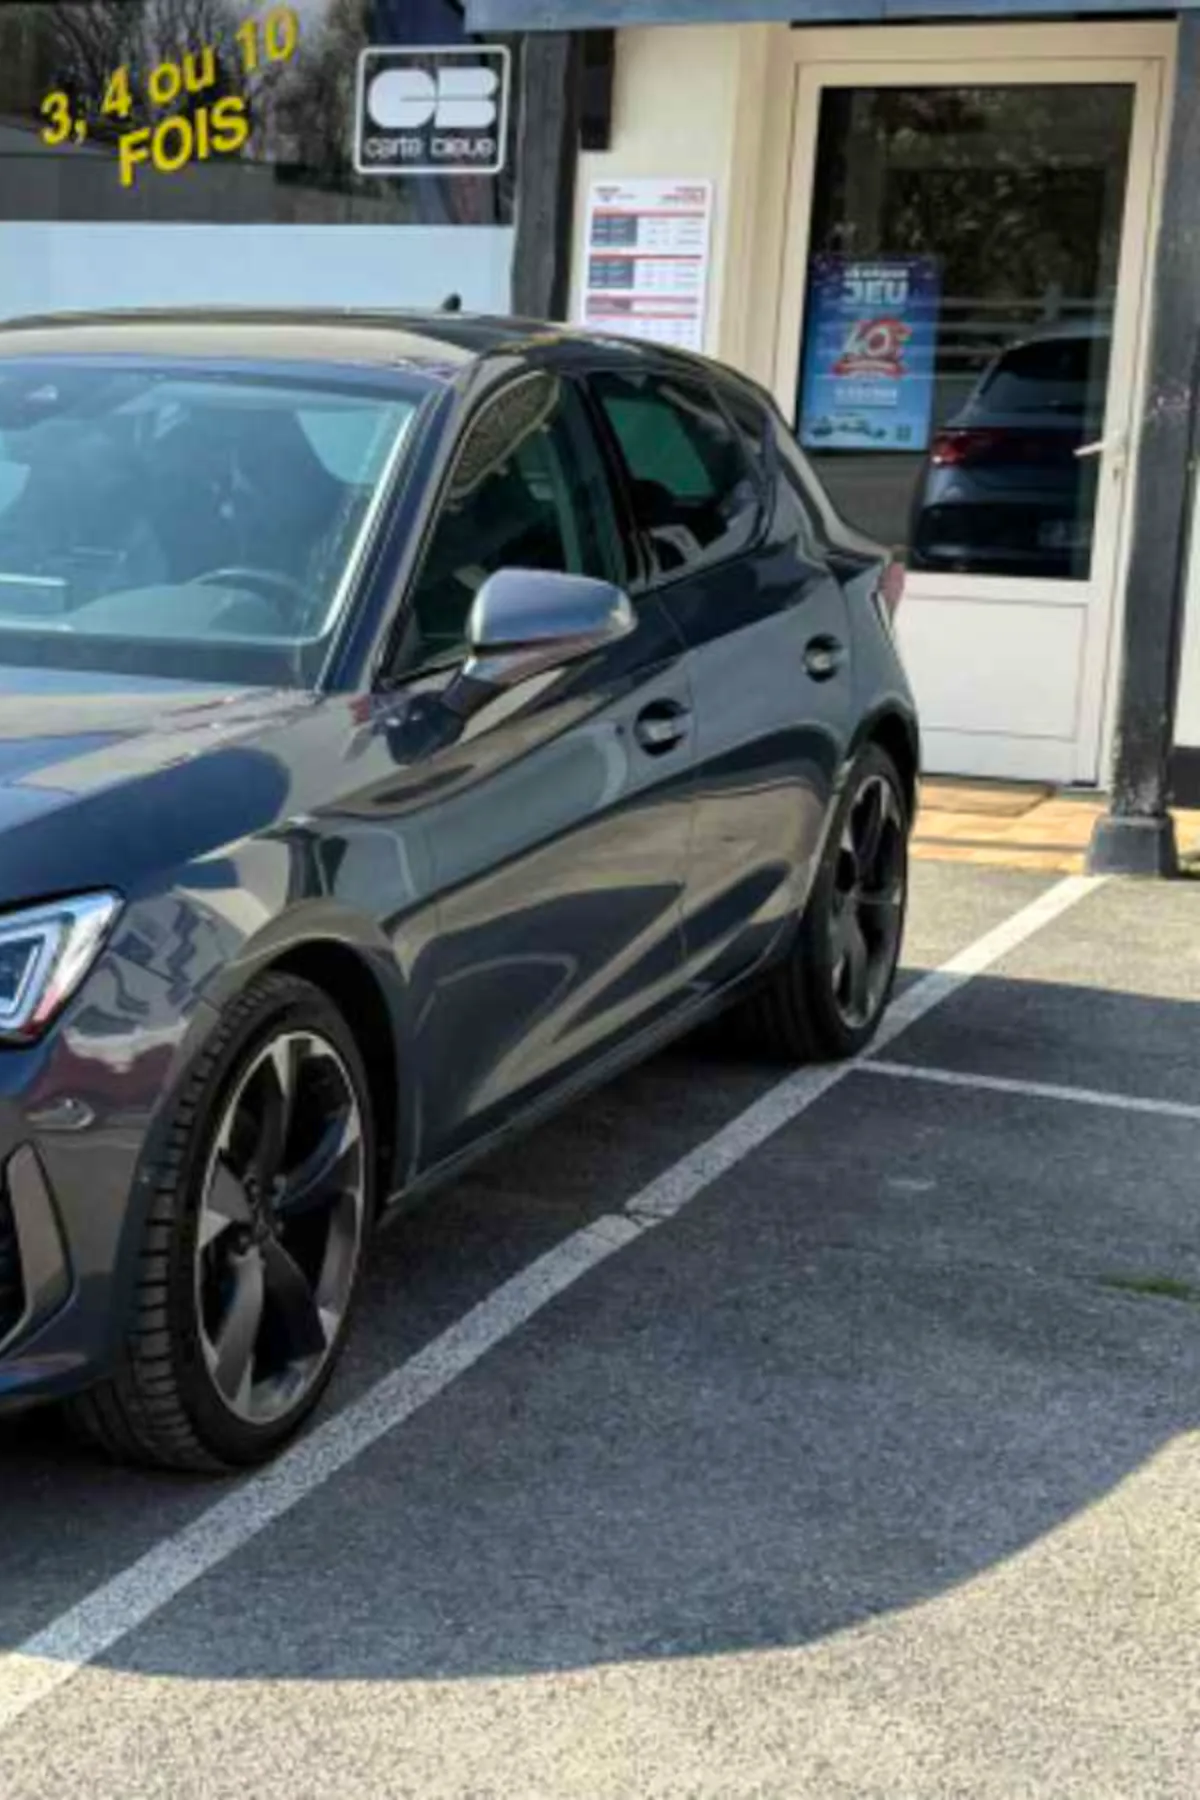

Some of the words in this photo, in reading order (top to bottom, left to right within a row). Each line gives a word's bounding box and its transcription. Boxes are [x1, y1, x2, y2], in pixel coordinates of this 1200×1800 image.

[40, 92, 88, 145] 3,
[101, 64, 131, 118] 4
[147, 46, 217, 103] ou
[234, 6, 298, 73] 10
[118, 95, 250, 187] FOIS
